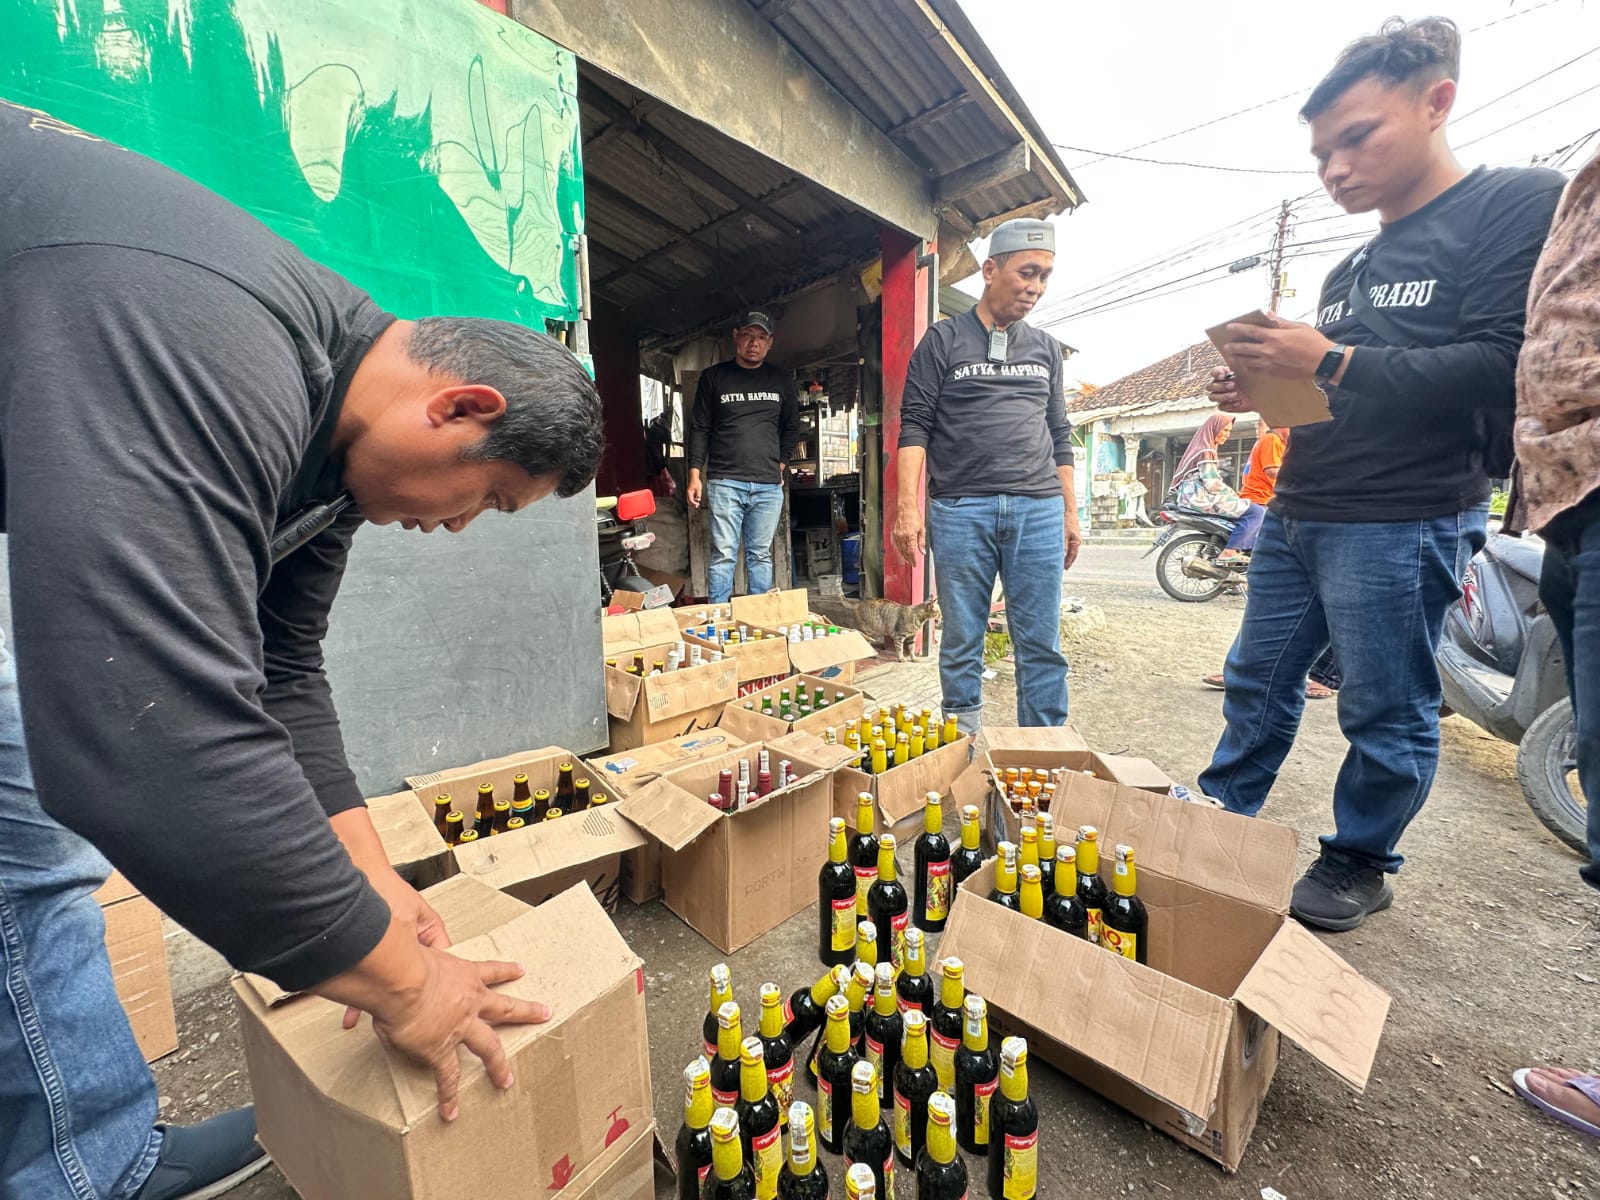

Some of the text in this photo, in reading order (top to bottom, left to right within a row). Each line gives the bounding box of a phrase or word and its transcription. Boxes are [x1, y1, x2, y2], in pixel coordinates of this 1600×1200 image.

[1318, 300, 1345, 328] TYA
[954, 363, 996, 380] SATYA
[720, 393, 745, 404] SATYA
